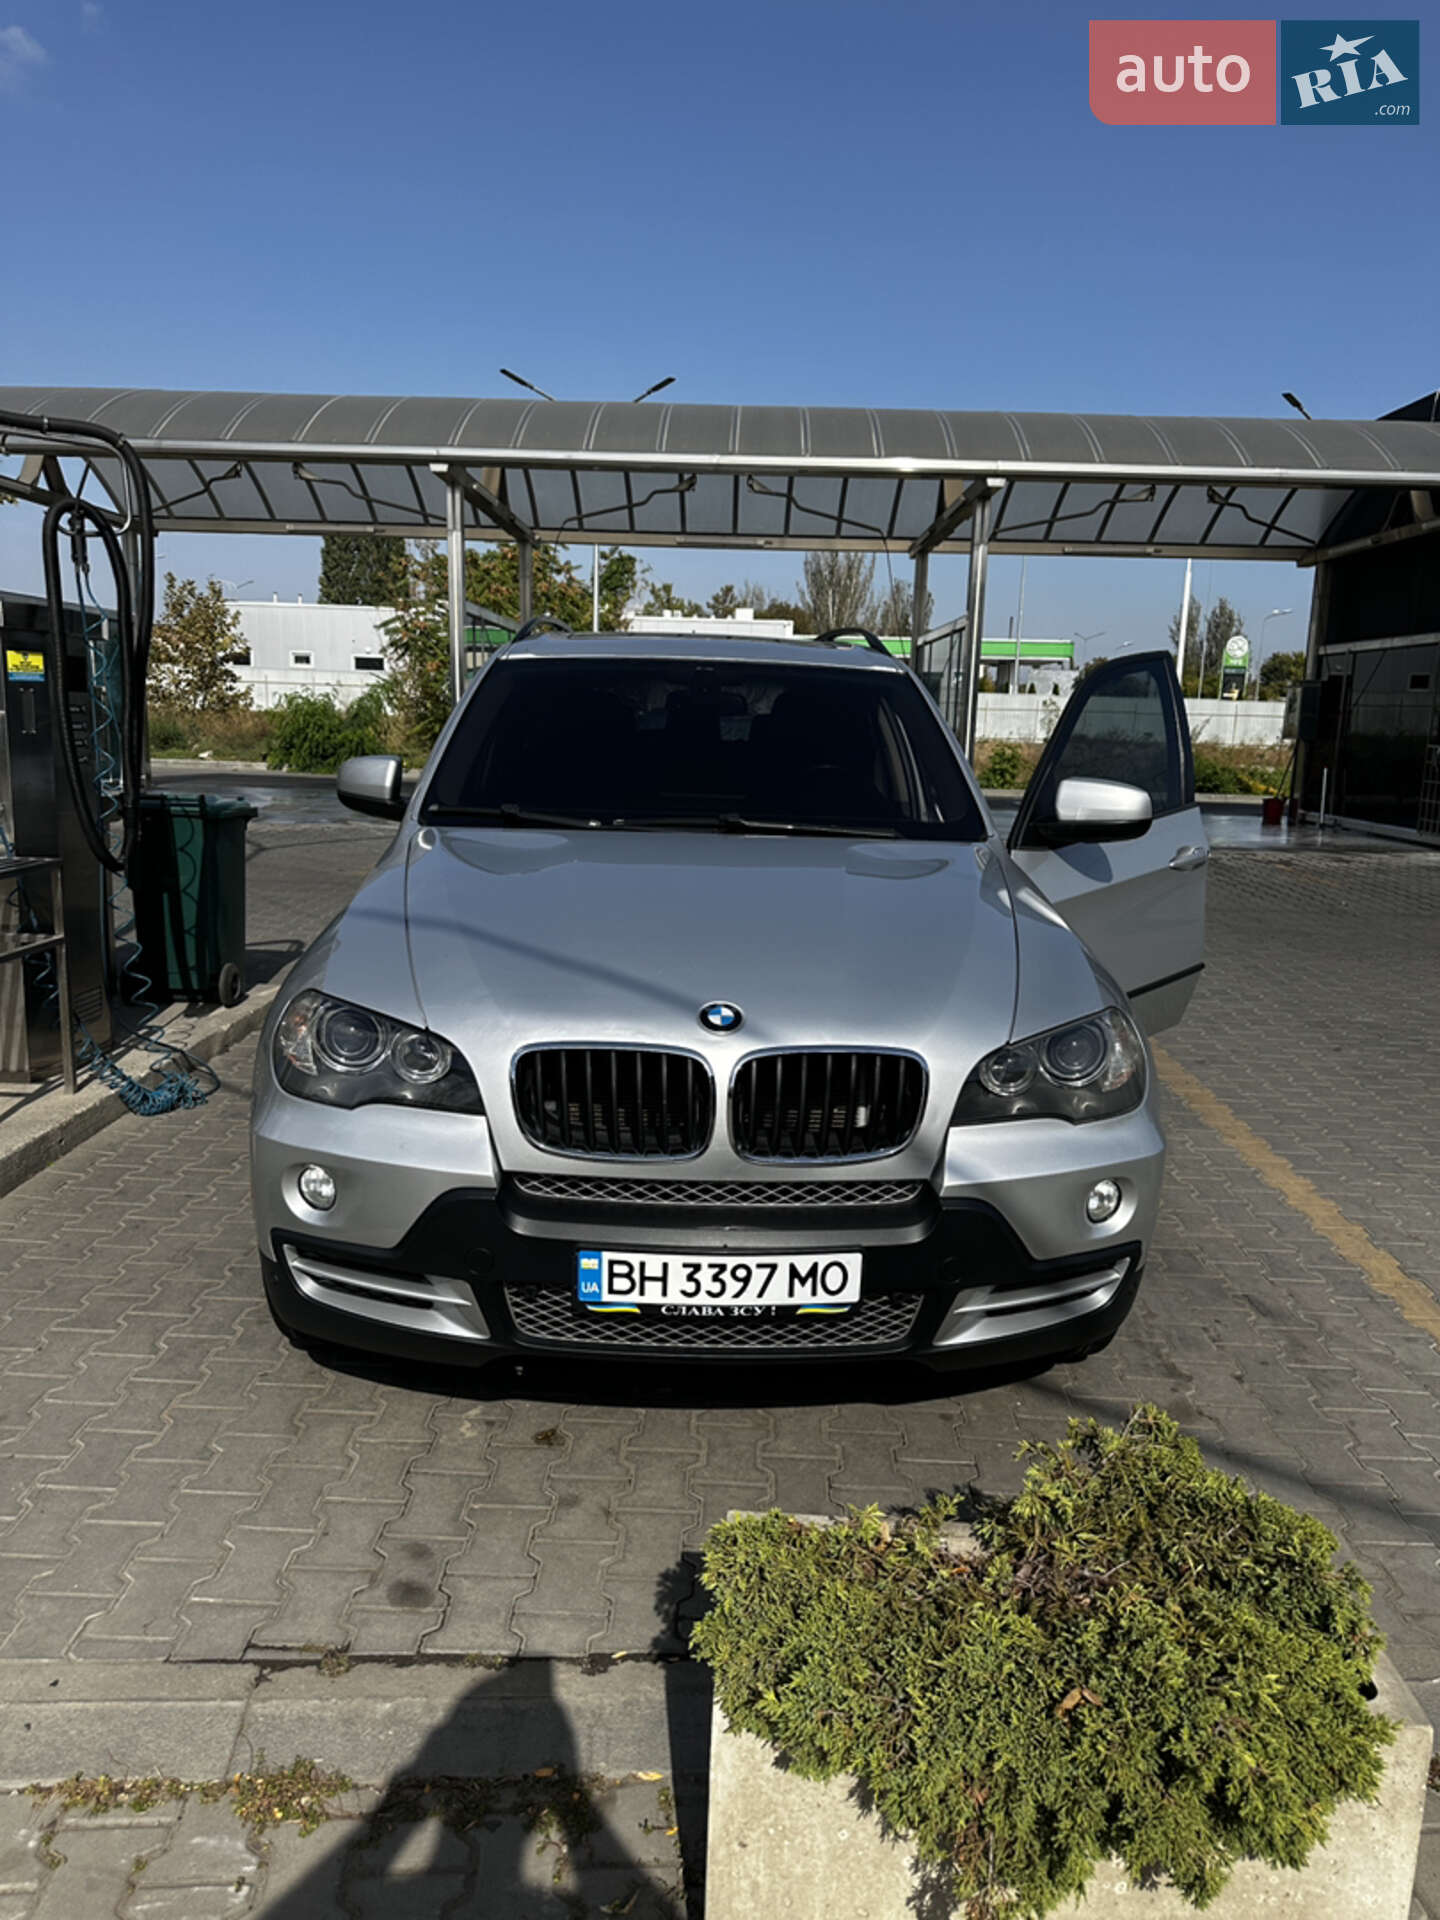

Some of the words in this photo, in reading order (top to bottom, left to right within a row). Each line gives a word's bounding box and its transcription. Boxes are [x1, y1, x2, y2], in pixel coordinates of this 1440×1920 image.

[607, 1260, 668, 1297] BH
[680, 1263, 778, 1299] 3397
[788, 1260, 849, 1297] MO
[581, 1281, 599, 1294] UA
[660, 1305, 724, 1317] СЛАВА
[730, 1305, 765, 1317] ЗСУ
